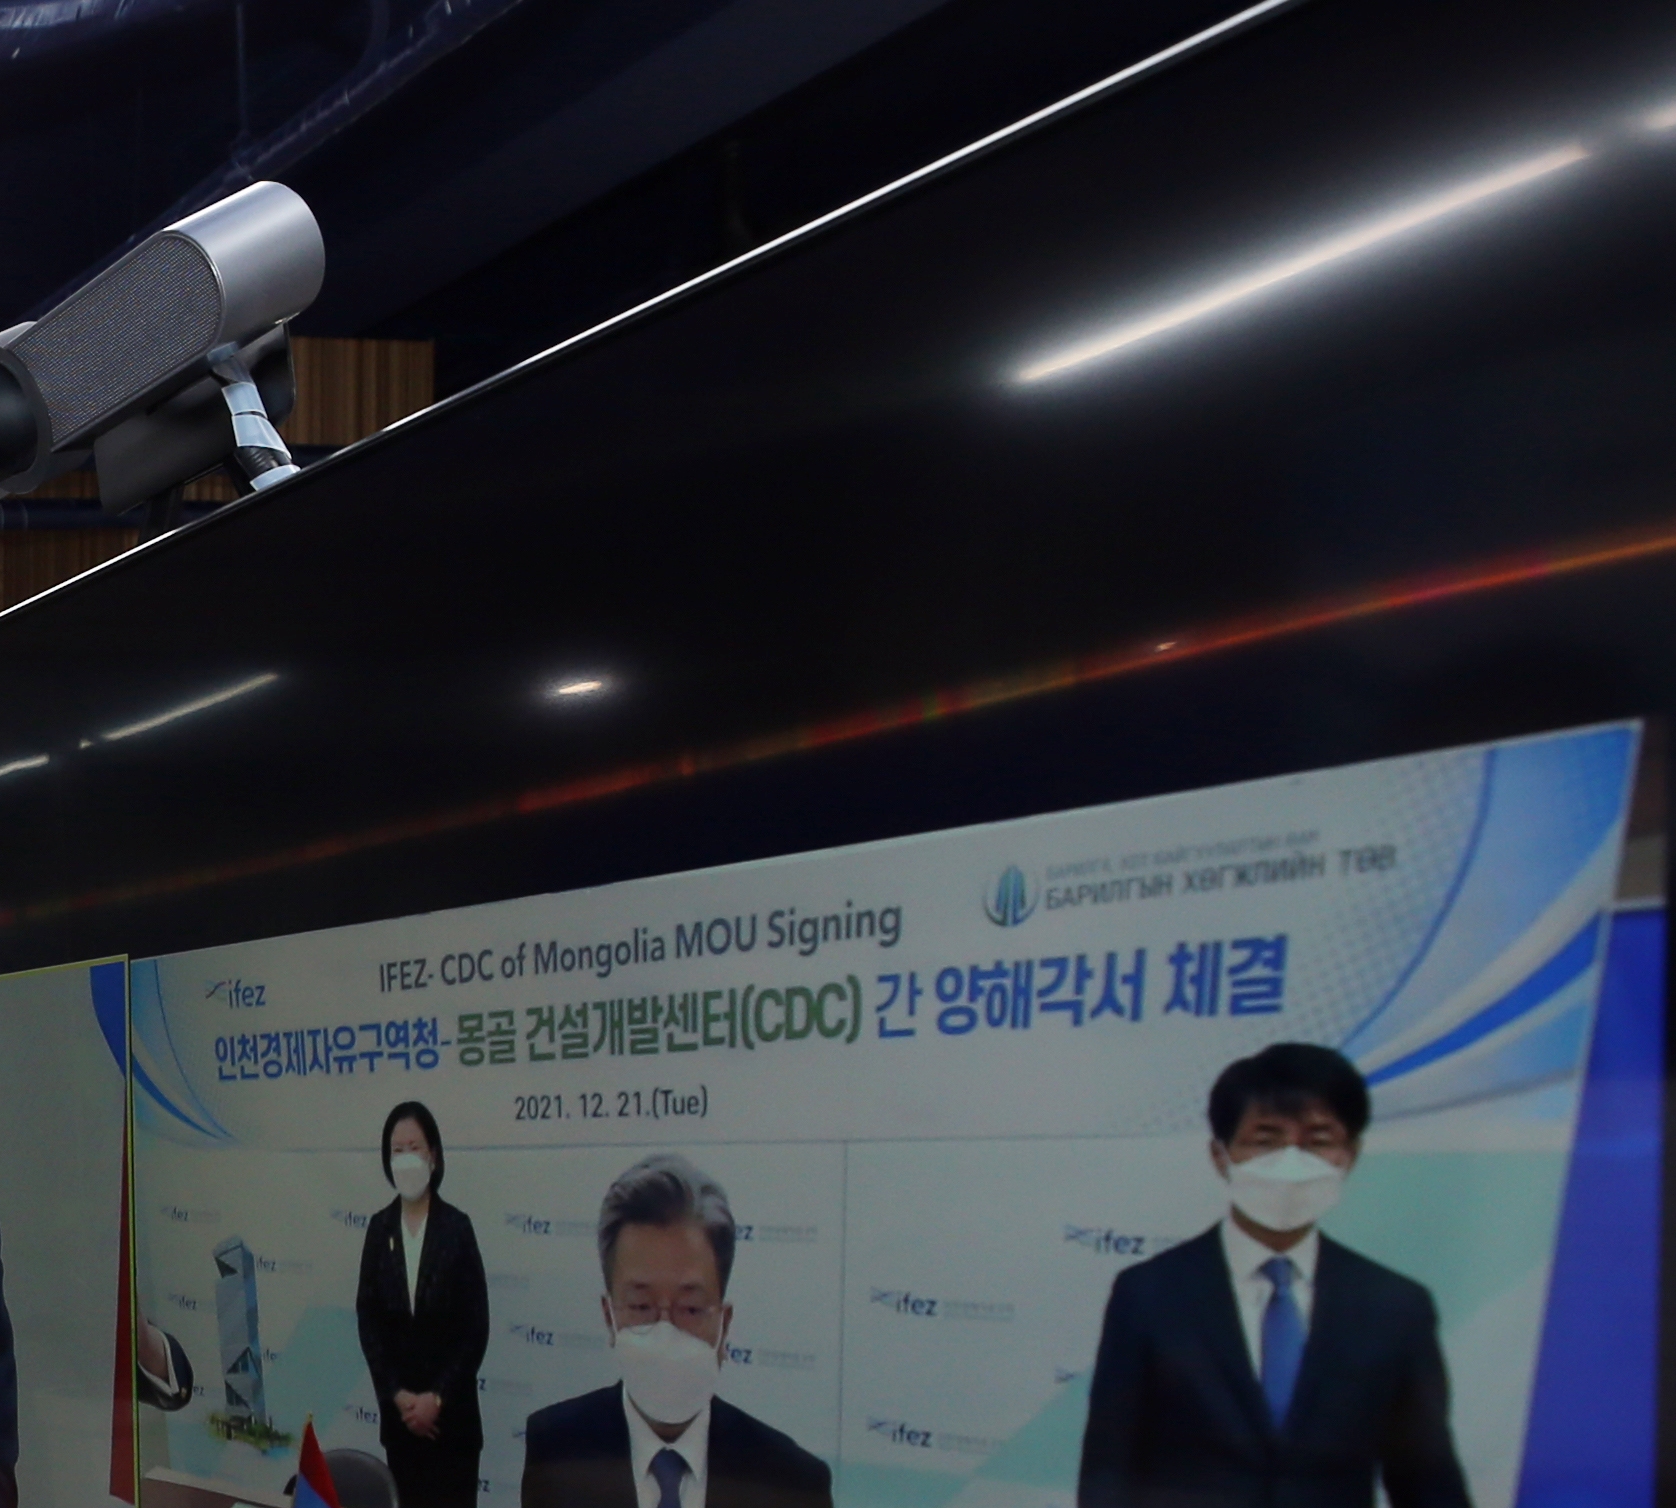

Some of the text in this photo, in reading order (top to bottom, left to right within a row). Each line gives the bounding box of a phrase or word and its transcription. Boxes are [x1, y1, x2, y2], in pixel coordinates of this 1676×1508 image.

[440, 949, 494, 986] CDC
[501, 941, 527, 979] of
[533, 927, 666, 979] Mongolia
[676, 913, 758, 960] MOU
[766, 899, 903, 957] Signing
[228, 980, 266, 1009] ifez
[524, 973, 863, 1061] 건설개발센터(CDC)
[875, 971, 924, 1039] 간
[934, 947, 1148, 1036] 양해각서
[1163, 931, 1289, 1019] 체결
[1093, 1228, 1146, 1256] ifez
[895, 1290, 938, 1317] ifez
[891, 1421, 933, 1448] ifez
